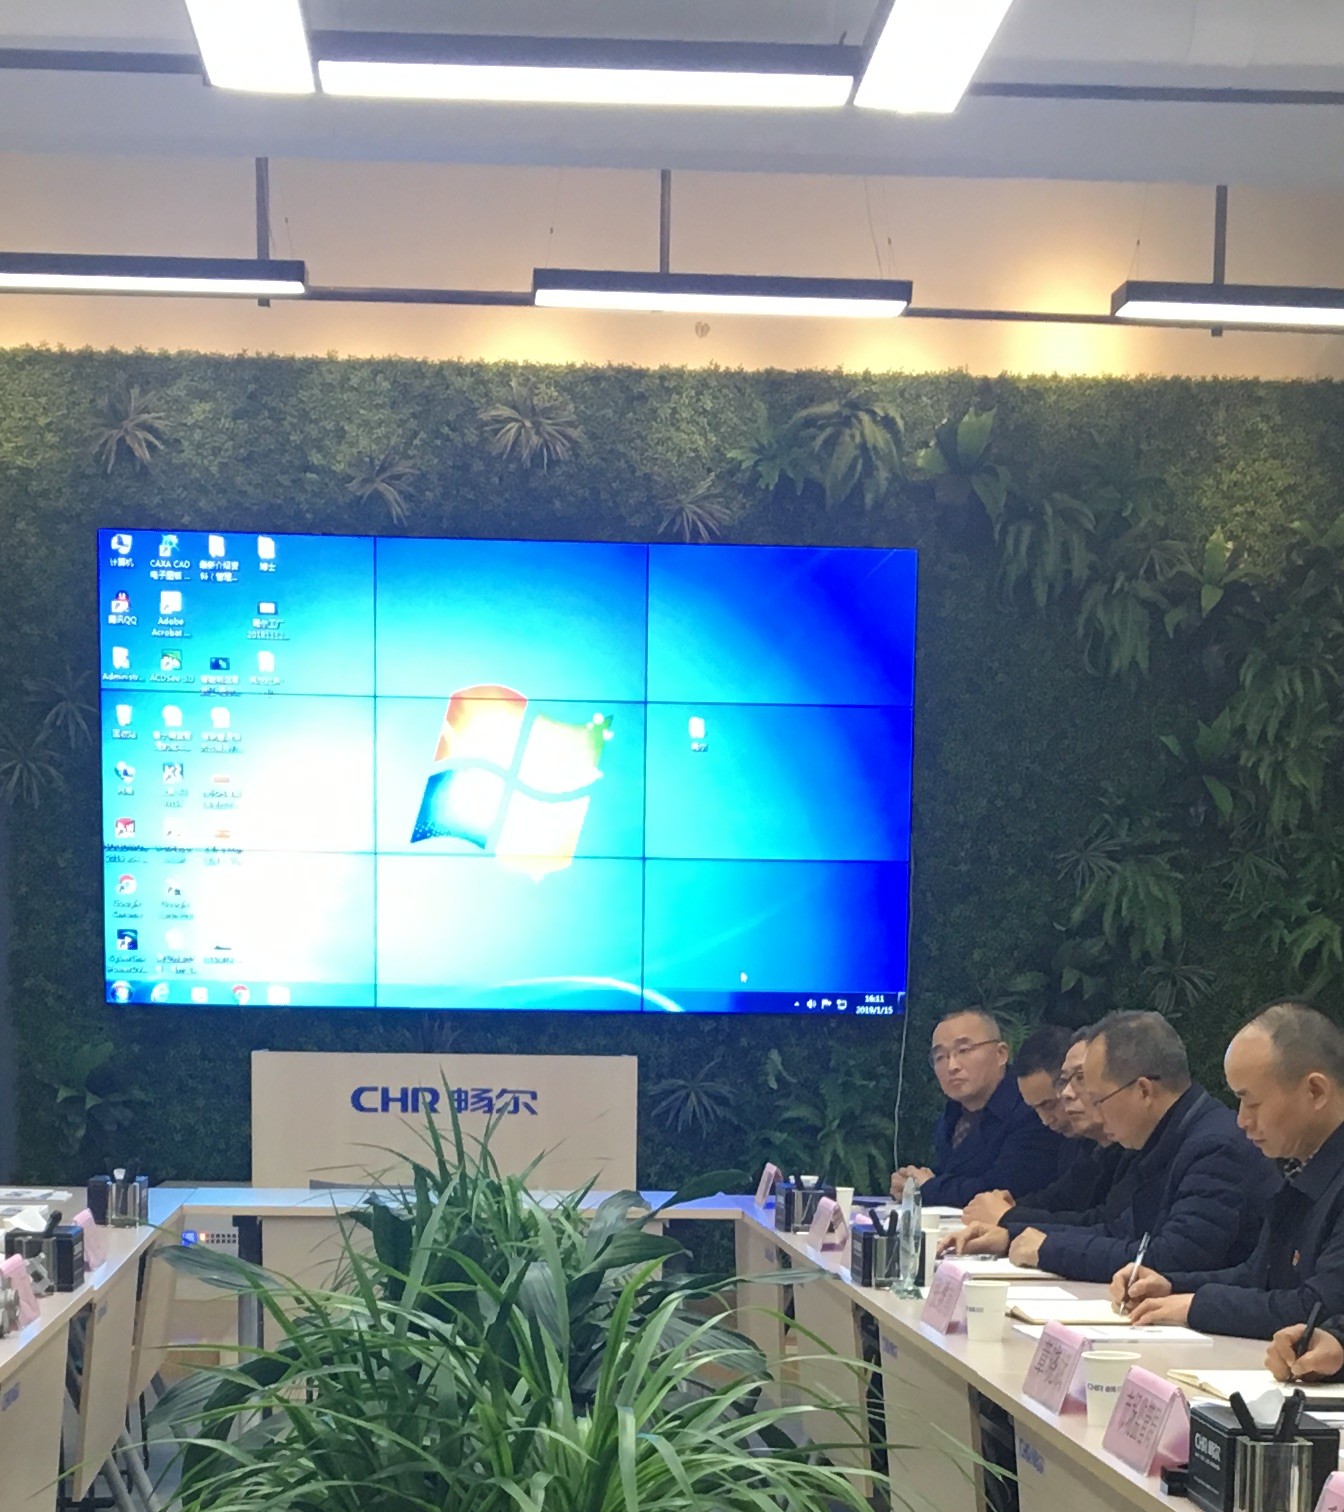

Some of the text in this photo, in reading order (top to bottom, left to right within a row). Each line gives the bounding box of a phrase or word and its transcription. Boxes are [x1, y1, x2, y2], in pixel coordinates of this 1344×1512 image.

[157, 616, 185, 626] Adobe
[350, 1086, 538, 1116] CHR 畅尔
